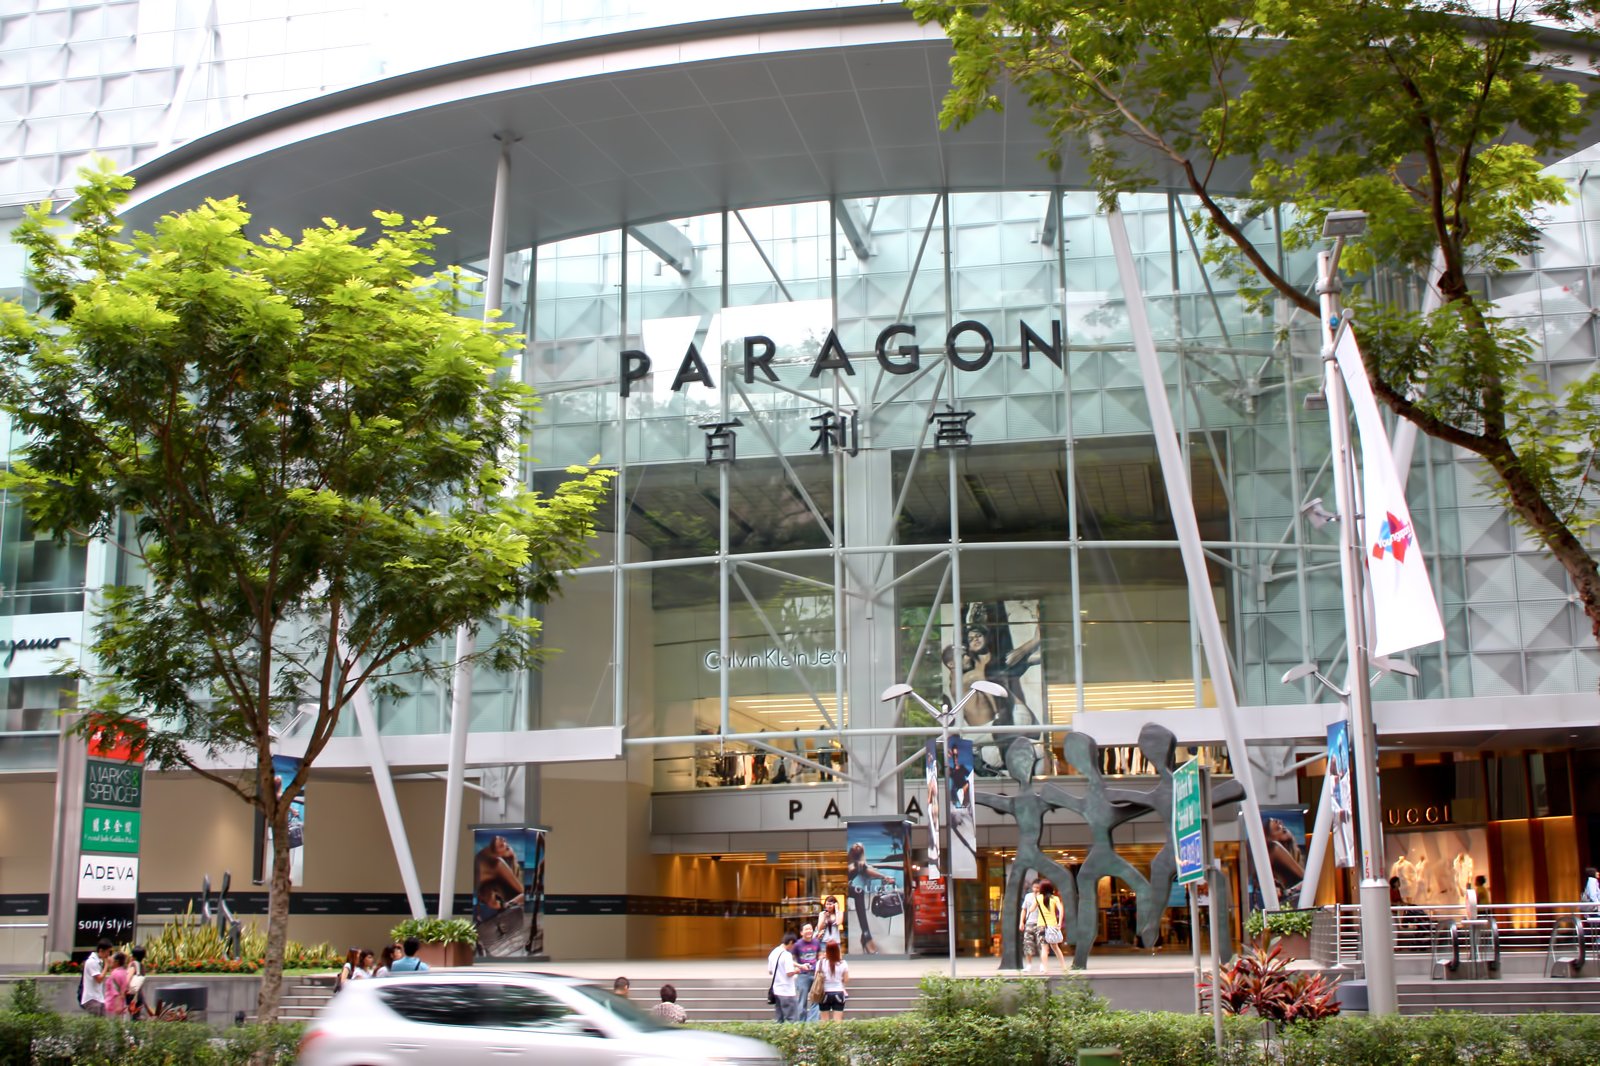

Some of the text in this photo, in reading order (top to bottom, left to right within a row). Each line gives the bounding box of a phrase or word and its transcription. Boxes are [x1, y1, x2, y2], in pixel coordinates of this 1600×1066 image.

[620, 319, 1063, 398] PARAGON
[1388, 804, 1449, 825] UCCI
[83, 863, 135, 880] ADEVA
